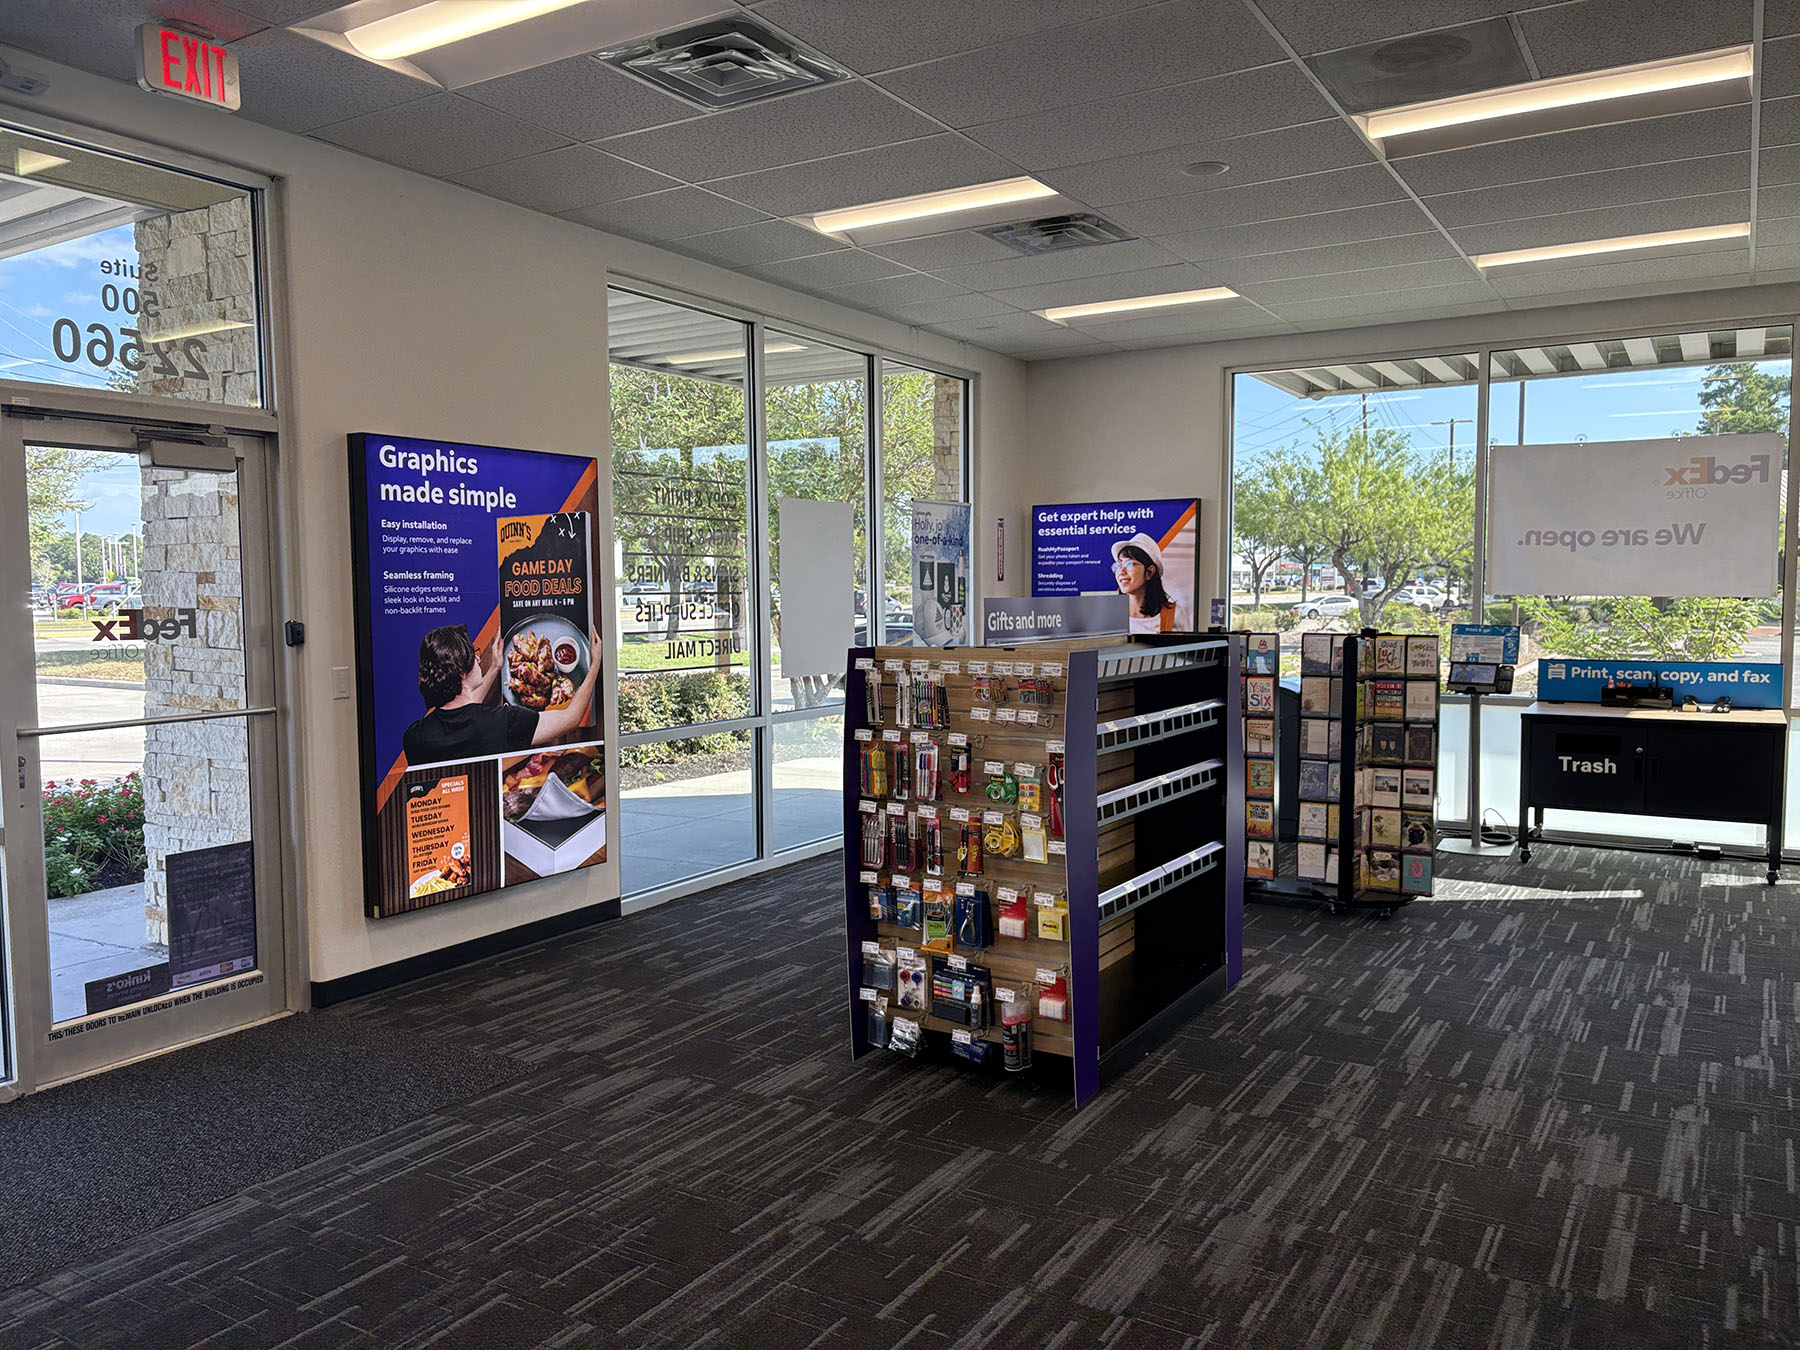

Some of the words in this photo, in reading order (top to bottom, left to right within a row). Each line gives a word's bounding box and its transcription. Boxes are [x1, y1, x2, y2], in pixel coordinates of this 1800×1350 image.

[159, 29, 227, 103] EXIT
[379, 444, 478, 477] Graphics
[380, 480, 444, 504] made
[448, 482, 517, 513] simple
[1038, 512, 1059, 523] Get
[1060, 510, 1098, 523] expert
[1100, 509, 1125, 522] help
[1127, 507, 1154, 519] with
[381, 519, 401, 531] Easy
[402, 520, 448, 530] installation
[914, 518, 935, 534] Holly,
[1038, 524, 1087, 536] essential
[1089, 523, 1137, 535] services
[500, 521, 532, 543] QUINN'S
[382, 534, 408, 544] Display,
[409, 536, 436, 544] remove,
[436, 536, 449, 544] and
[449, 537, 473, 546] replace
[914, 534, 964, 547] one-of-a-kind
[382, 546, 399, 554] your
[399, 545, 428, 554] graphics
[511, 560, 546, 577] GAME
[548, 558, 573, 574] DAY
[383, 570, 422, 580] Seamless
[423, 570, 454, 582] framing
[384, 585, 410, 593] Silicone
[411, 585, 432, 594] edges
[504, 579, 541, 598] FOOD
[542, 577, 583, 595] DEALS
[384, 596, 402, 604] sleek
[402, 596, 418, 604] look
[425, 595, 448, 603] backlit
[448, 595, 461, 603] and
[512, 600, 525, 608] SAVE
[525, 599, 532, 607] ON
[532, 599, 541, 607] ANY
[542, 598, 554, 606] MEAL
[385, 606, 423, 614] non-backlit
[423, 605, 447, 613] frames
[988, 611, 1014, 632] Gifts
[1015, 610, 1035, 630] and
[1037, 613, 1062, 629] more
[1571, 666, 1613, 681] Print,
[1616, 668, 1657, 683] scan,
[1660, 669, 1704, 684] copy,
[1707, 669, 1739, 683] and
[1742, 670, 1771, 684] fax
[1249, 694, 1272, 707] Six
[1558, 756, 1617, 774] Trash
[441, 780, 465, 789] SPECIALS
[451, 786, 465, 794] WEEK
[410, 798, 442, 808] MONDAY
[411, 812, 442, 823] TUESDAY
[411, 825, 455, 839] WEDNESDAY
[412, 841, 449, 854] THURSDAY
[412, 857, 438, 869] FRIDAY
[48, 1024, 84, 1042] THIS/THESE
[85, 1018, 107, 1035] DOORS
[107, 1015, 117, 1027] TO
[117, 1009, 142, 1023] REMAIN
[142, 1001, 173, 1016] UNLOCKED
[174, 995, 191, 1008] WHEN
[191, 992, 204, 1003] THE
[204, 985, 230, 999] BUILDING
[230, 982, 237, 993] IS
[237, 975, 264, 989] OCCUPIED
